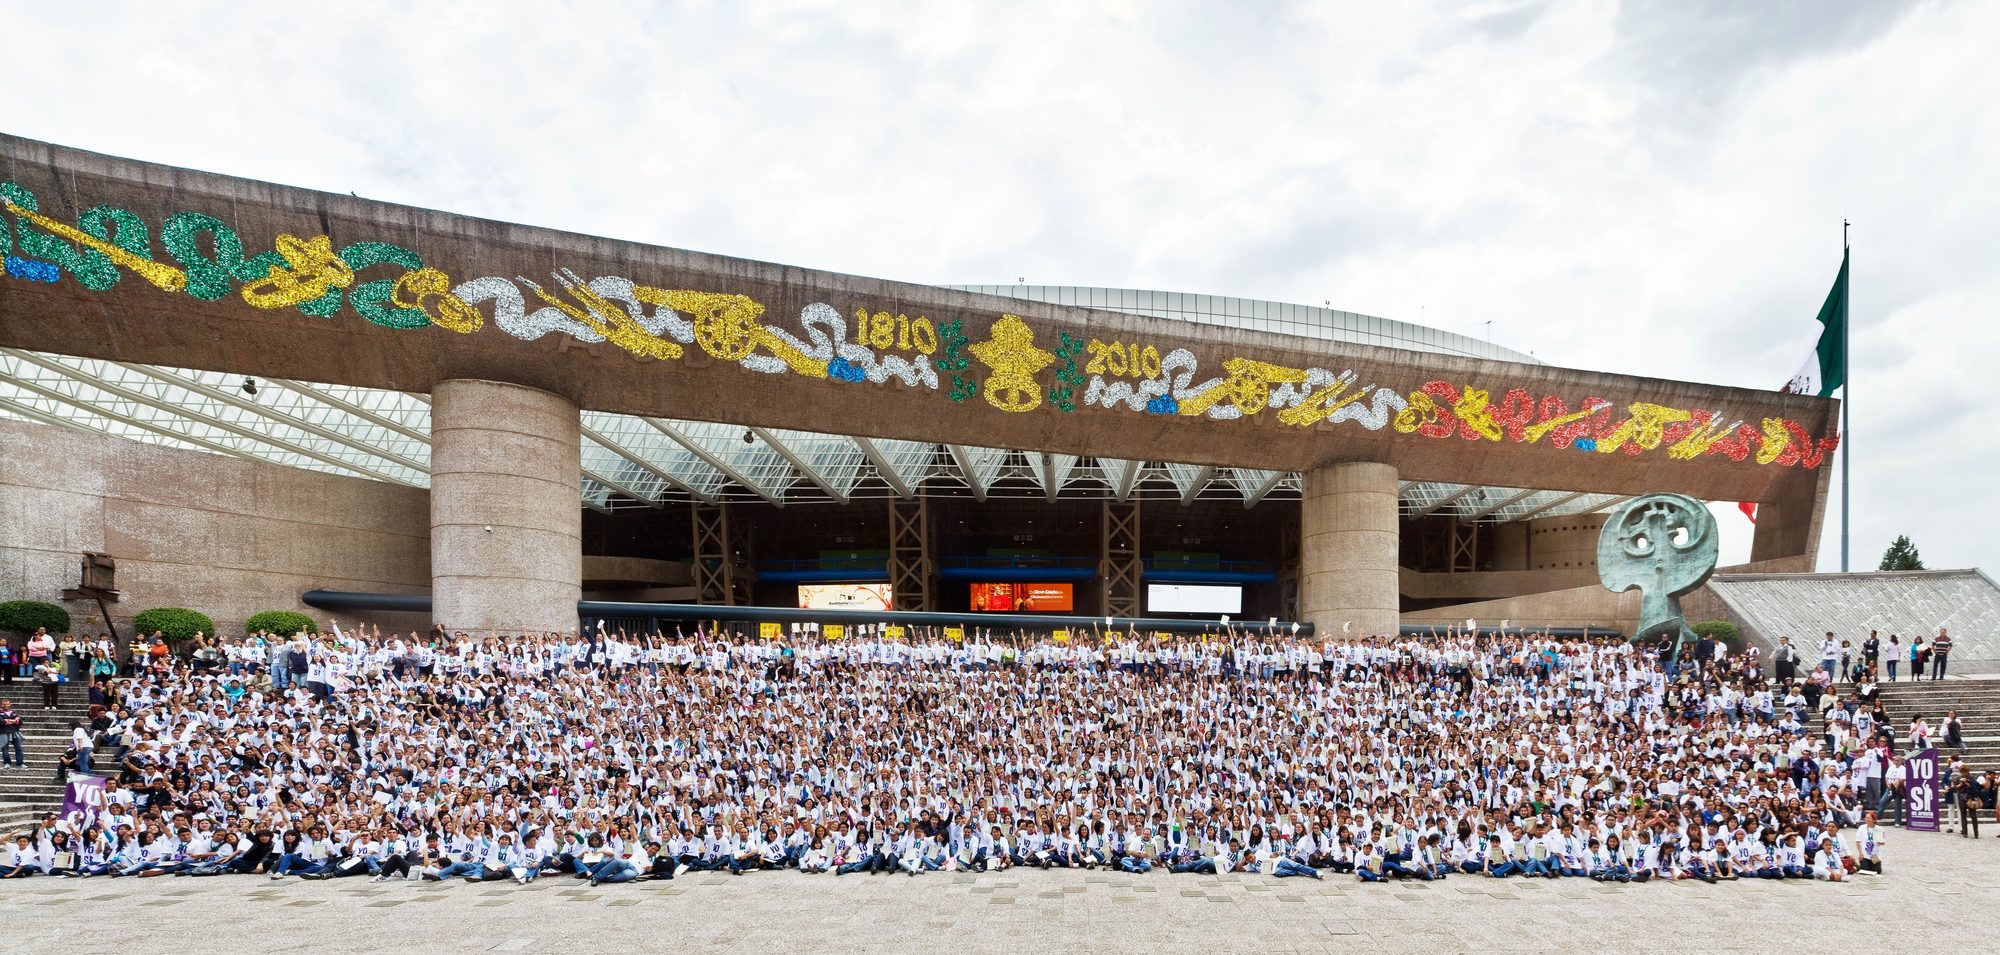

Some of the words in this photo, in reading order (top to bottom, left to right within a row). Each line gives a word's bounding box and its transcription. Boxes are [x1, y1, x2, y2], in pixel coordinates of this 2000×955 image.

[855, 307, 938, 355] 1810
[1086, 338, 1161, 379] 2010
[1909, 758, 1934, 780] YO
[1739, 848, 1748, 857] YO
